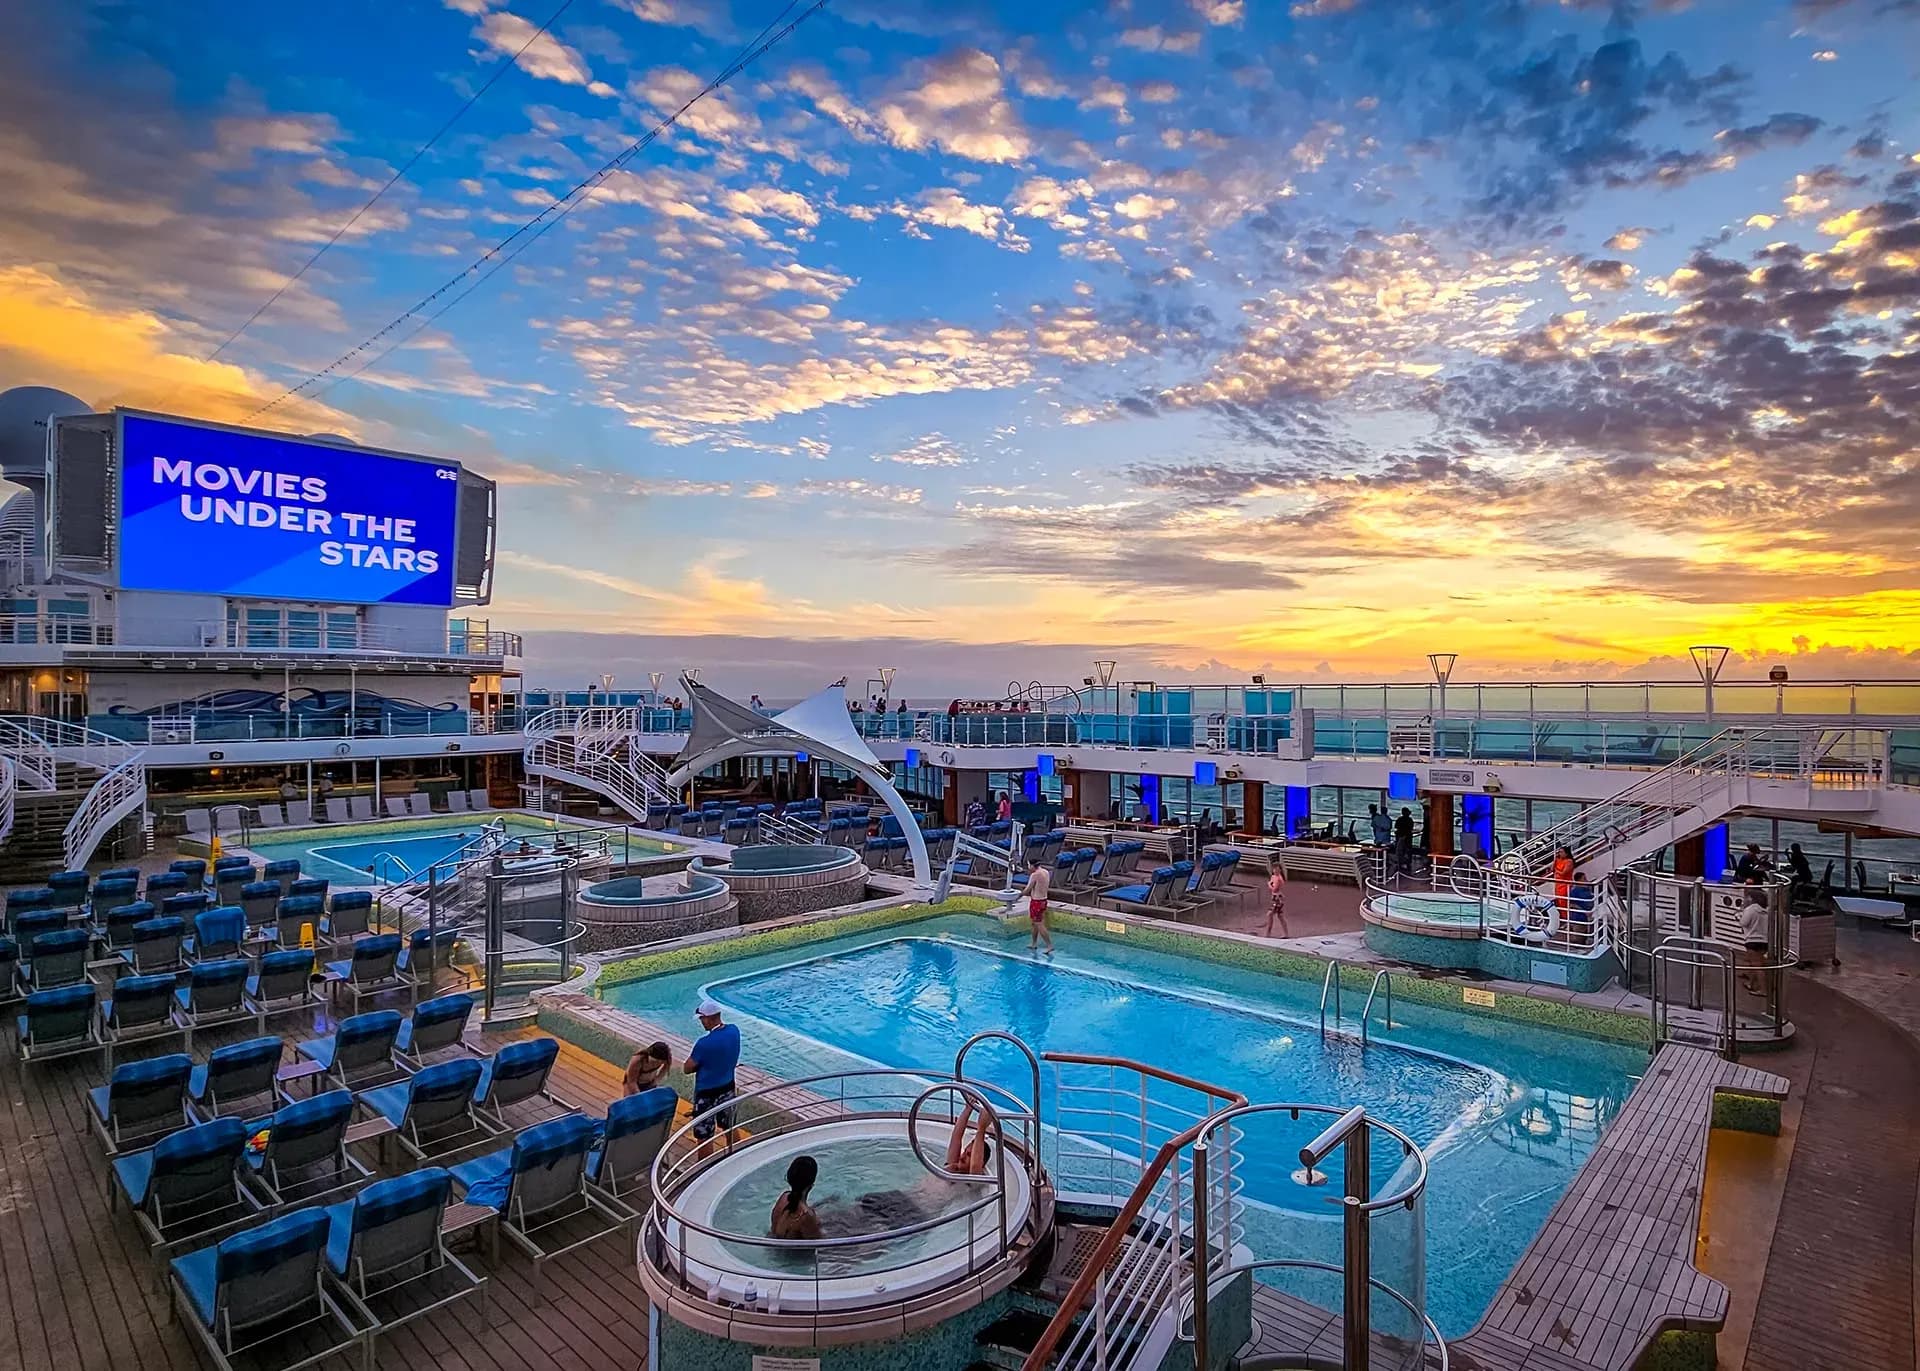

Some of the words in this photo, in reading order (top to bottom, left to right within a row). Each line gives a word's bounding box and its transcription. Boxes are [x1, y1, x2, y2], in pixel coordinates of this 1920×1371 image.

[152, 456, 328, 504] MOVIES
[180, 494, 333, 535] UNDER
[341, 512, 417, 543] THE
[319, 541, 439, 574] STARS
